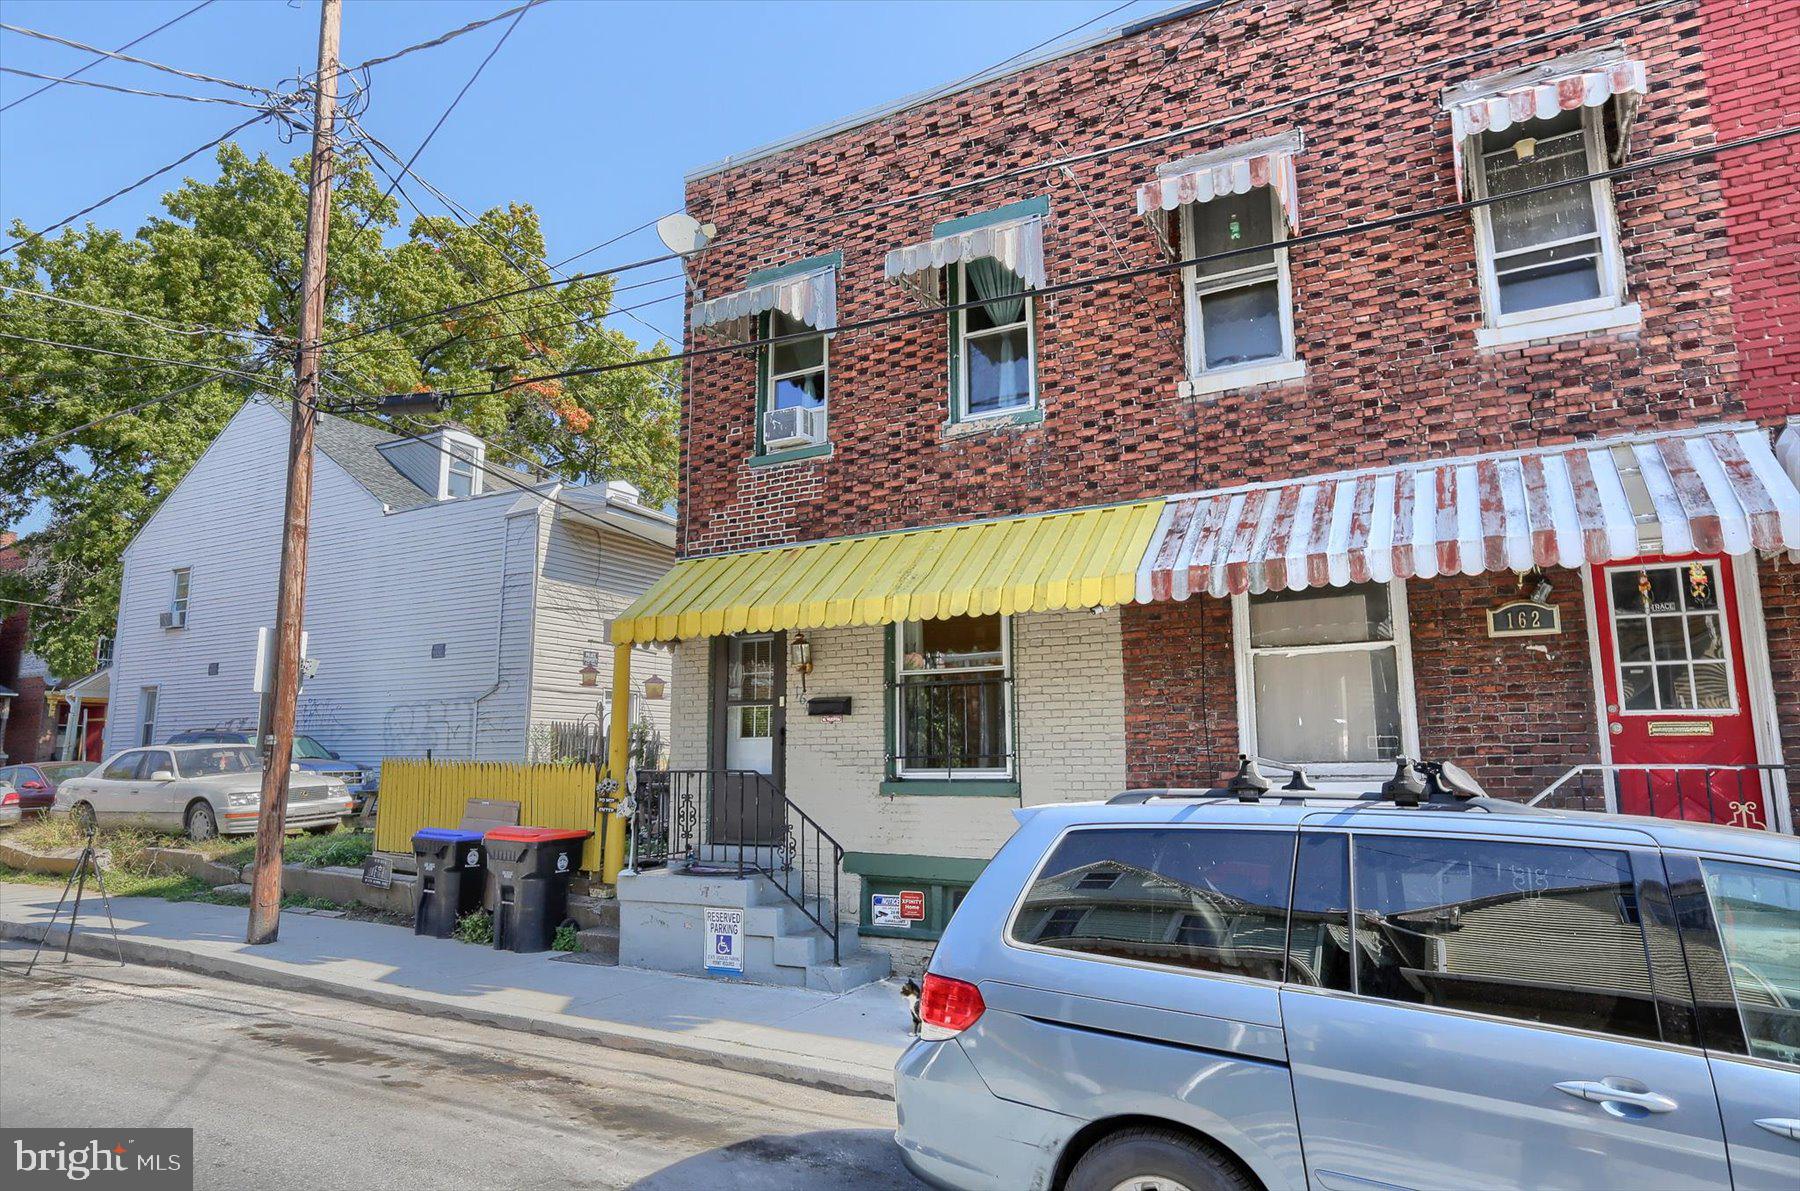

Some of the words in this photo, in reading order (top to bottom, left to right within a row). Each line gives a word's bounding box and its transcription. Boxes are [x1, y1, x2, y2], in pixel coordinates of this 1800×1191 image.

[1507, 611, 1540, 629] 162
[707, 912, 741, 923] RESERVED
[711, 923, 738, 934] PARKING
